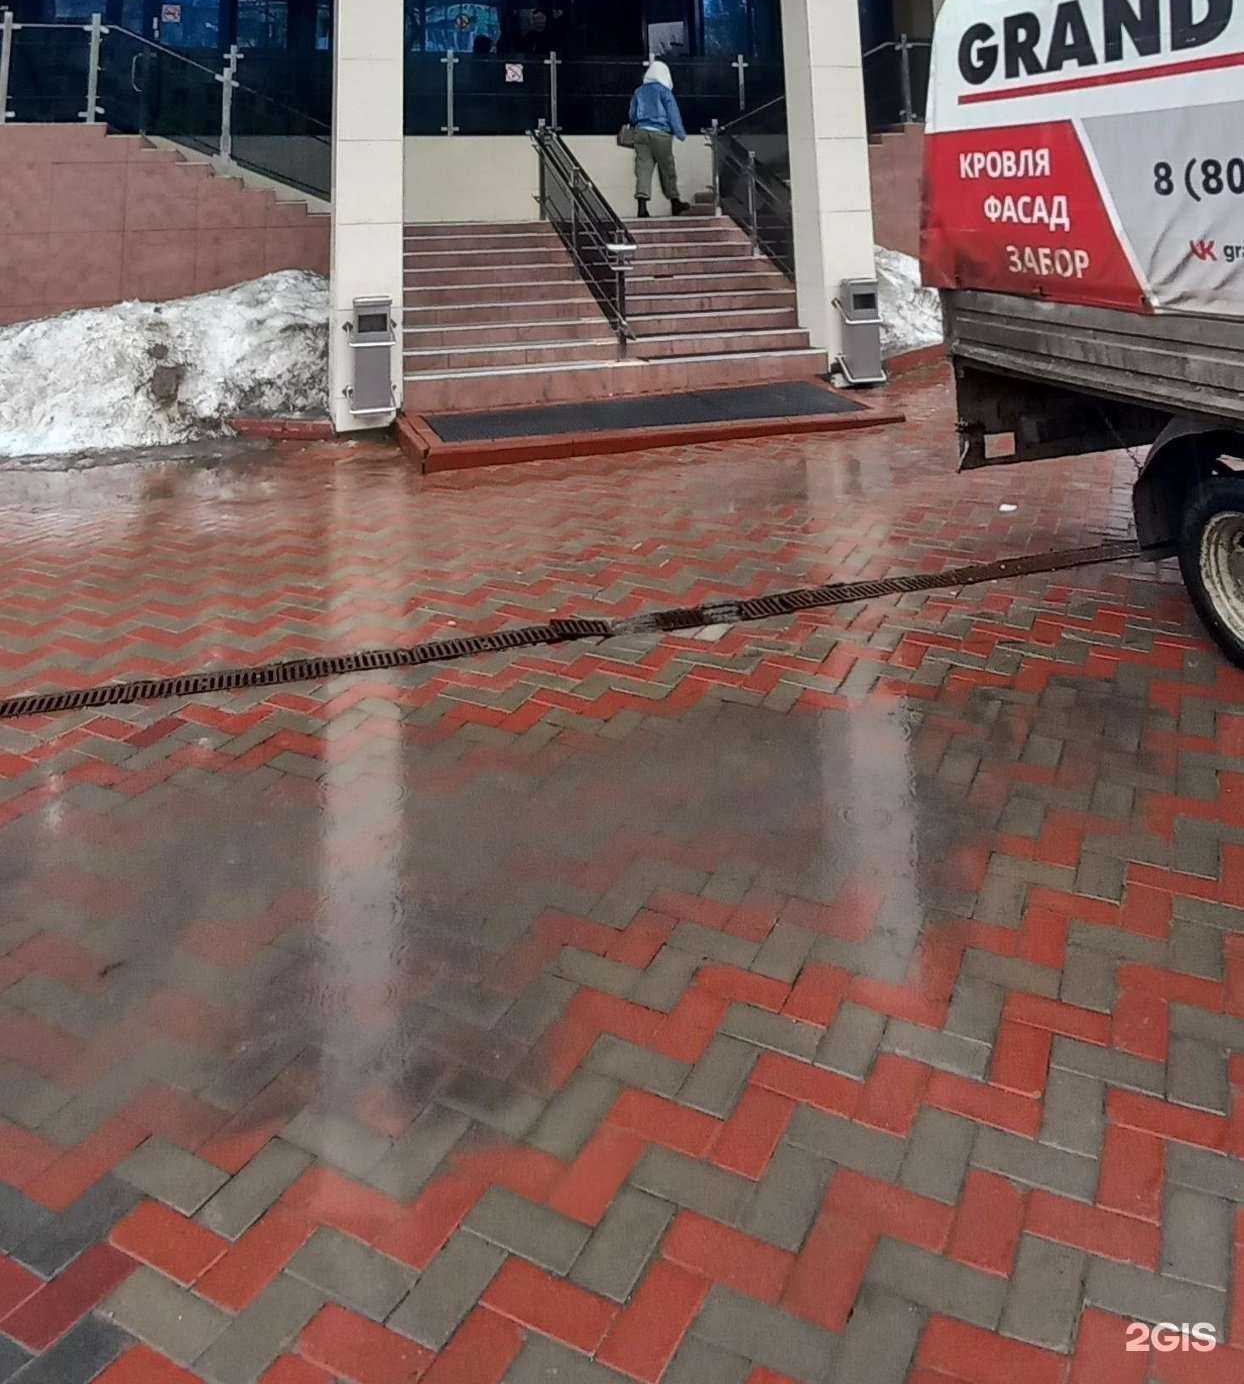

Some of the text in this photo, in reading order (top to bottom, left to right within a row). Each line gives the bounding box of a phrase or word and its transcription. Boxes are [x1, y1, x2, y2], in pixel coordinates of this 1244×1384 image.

[960, 148, 1050, 178] КРОВЛЯ
[1154, 162, 1174, 196] 8
[984, 195, 1070, 232] ФАСАД
[1006, 245, 1090, 278] ЗАБОР
[1223, 245, 1244, 263] gr
